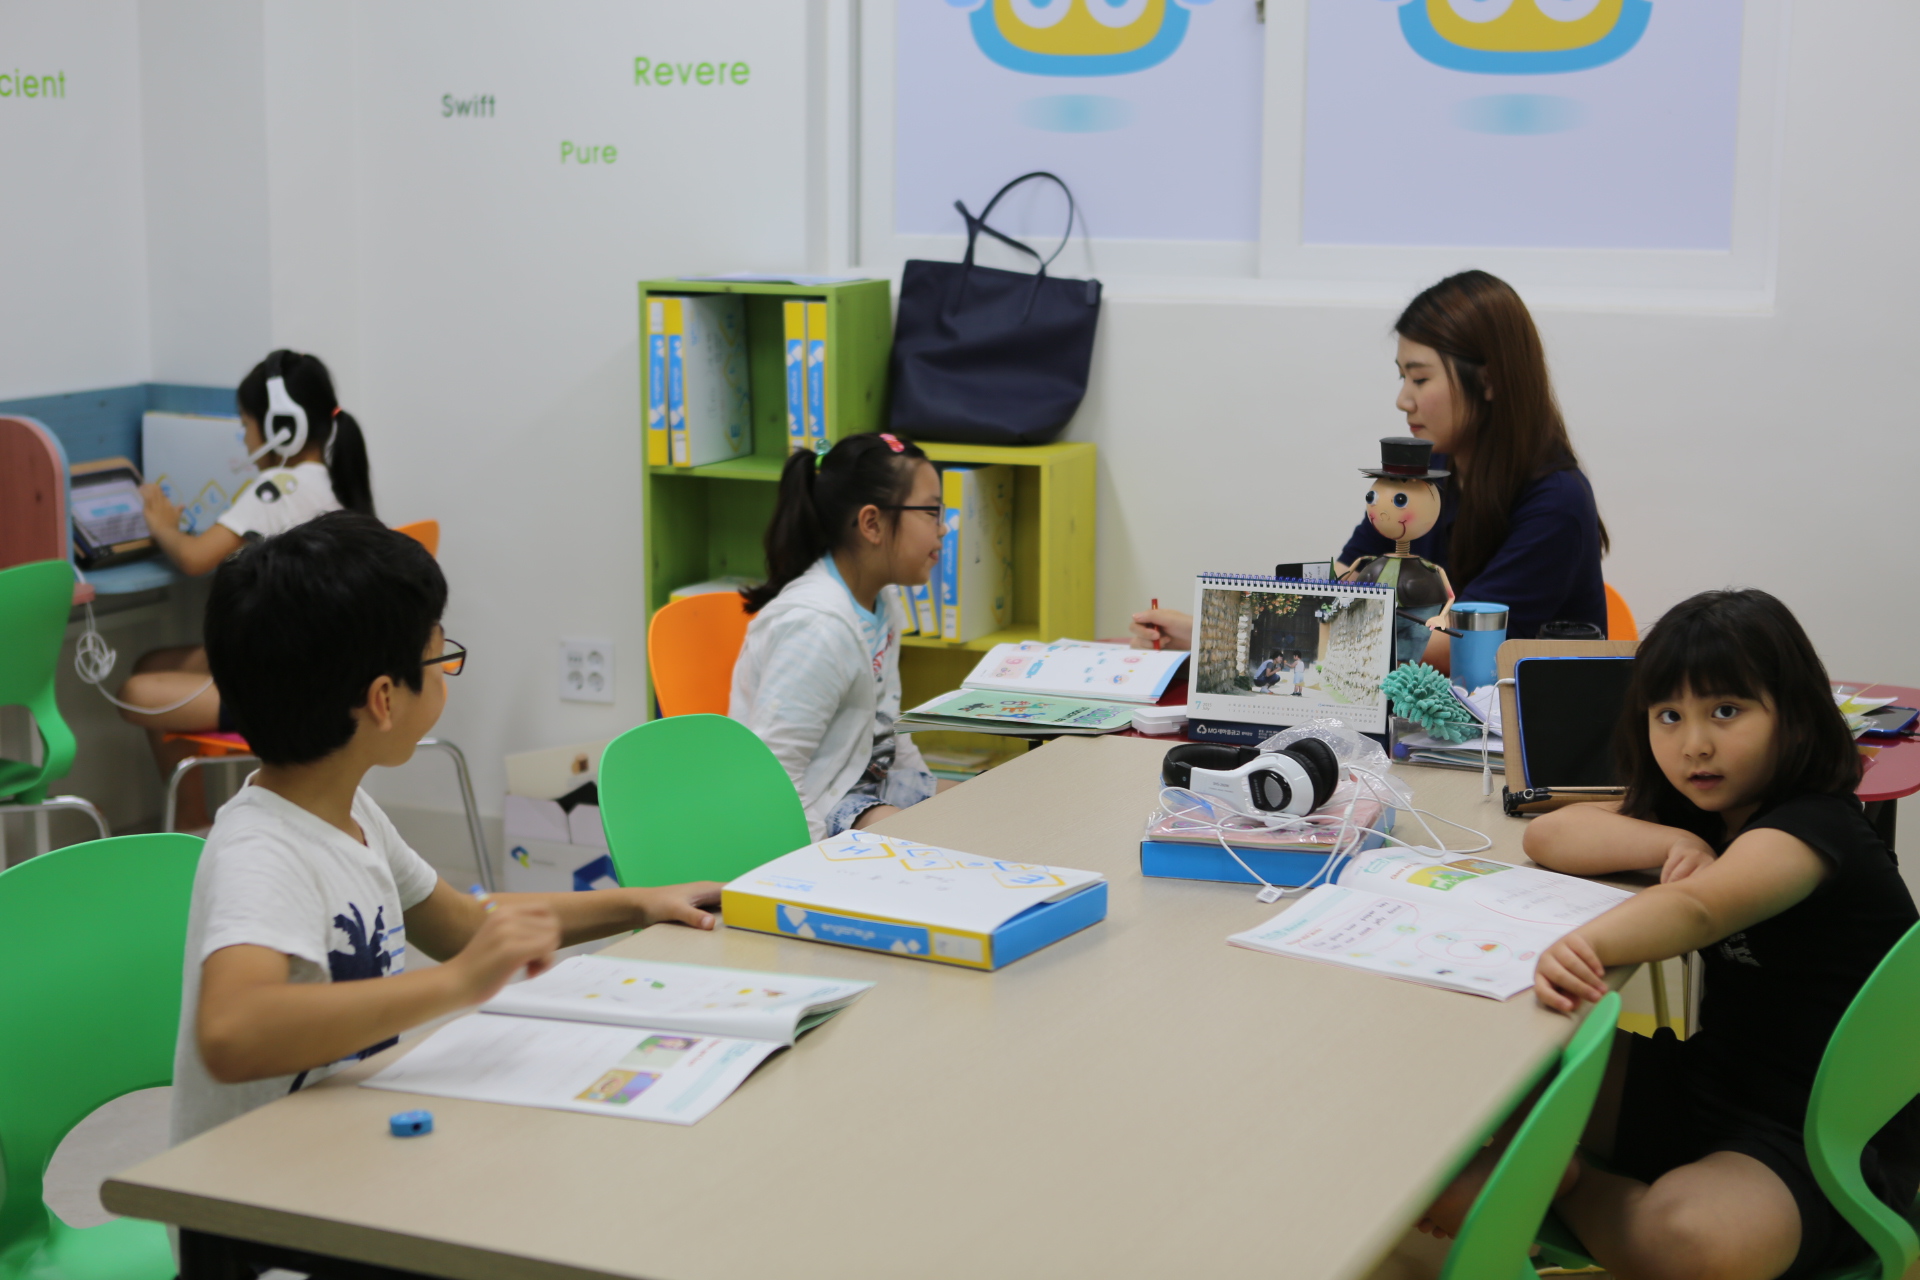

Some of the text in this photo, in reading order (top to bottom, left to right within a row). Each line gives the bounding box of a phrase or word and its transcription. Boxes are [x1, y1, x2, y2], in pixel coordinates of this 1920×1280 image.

[0, 68, 66, 98] cient
[634, 56, 750, 86] Revere
[441, 93, 496, 118] Swift
[560, 140, 618, 164] Pure
